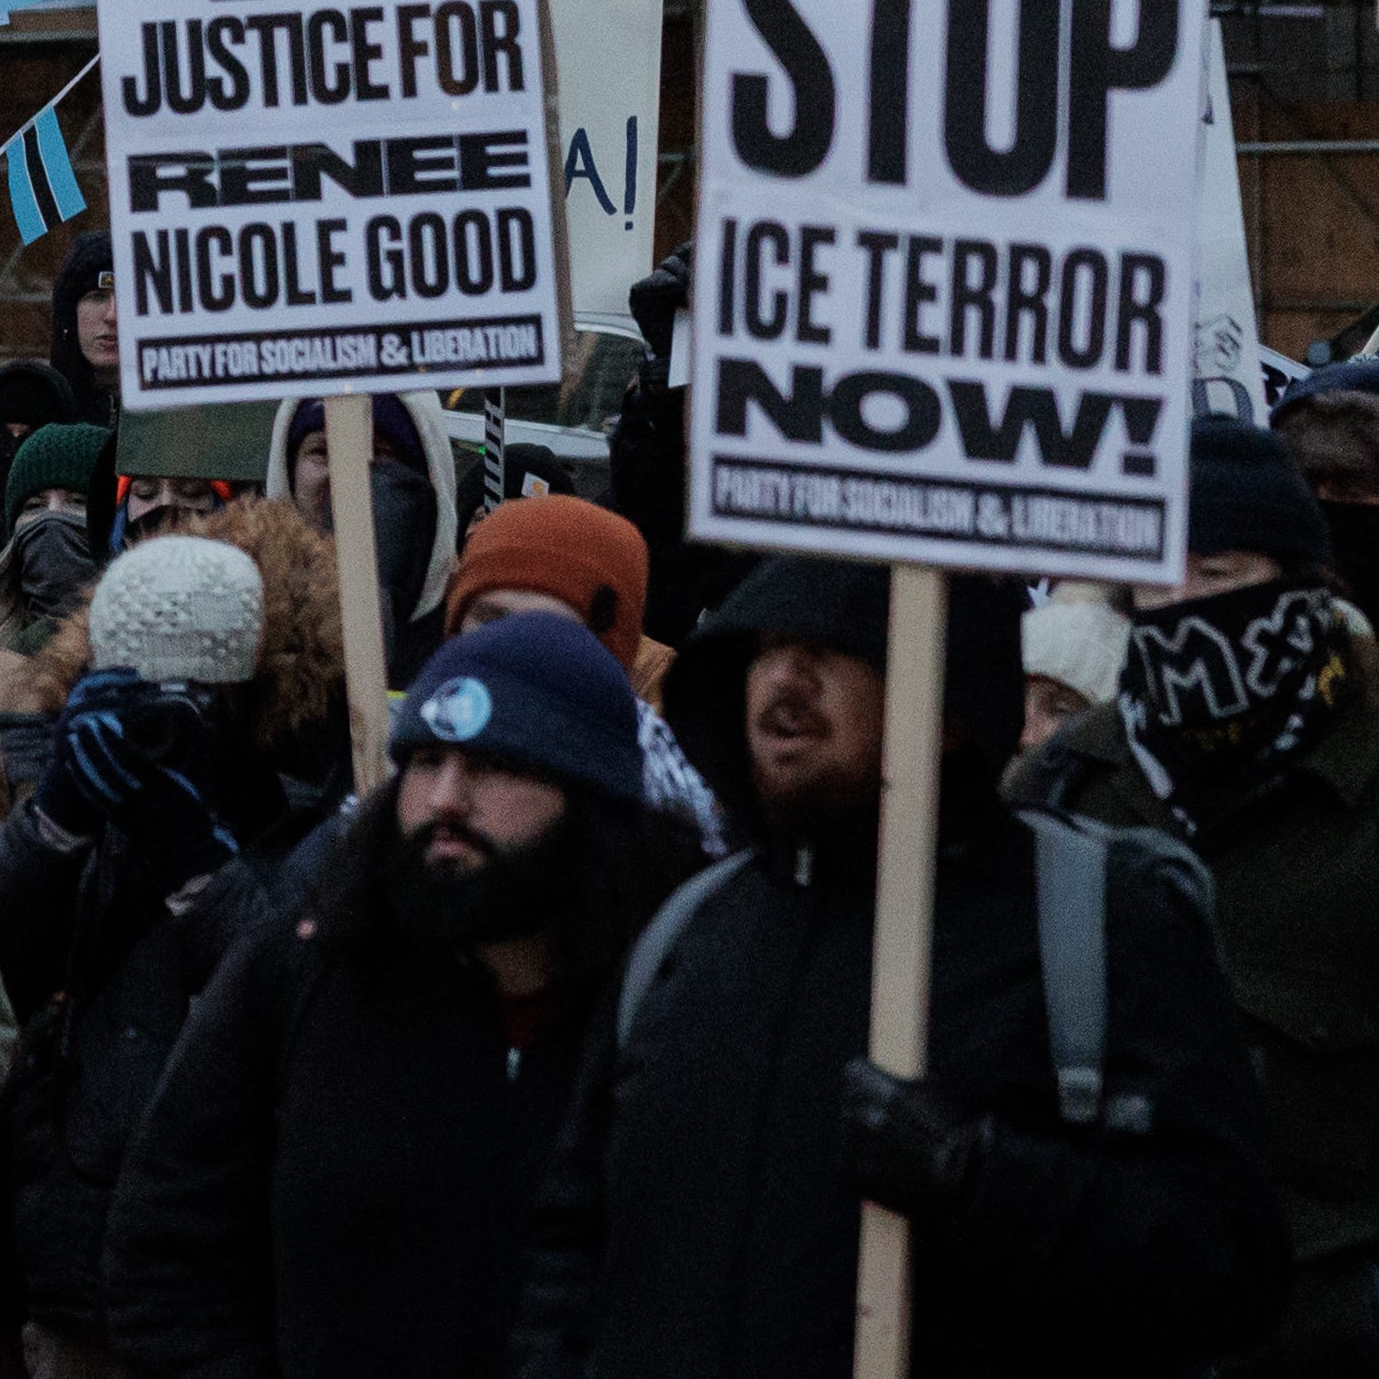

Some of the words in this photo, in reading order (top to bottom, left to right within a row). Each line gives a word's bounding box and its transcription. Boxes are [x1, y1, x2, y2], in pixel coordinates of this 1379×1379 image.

[121, 6, 389, 119] JUSTICE
[127, 129, 533, 214] RENEE
[131, 217, 353, 316] NICOLE
[365, 206, 537, 302] GOOD
[717, 218, 834, 346] ICE
[858, 229, 1167, 376] TERROR
[143, 343, 215, 382] PARTY
[215, 341, 259, 377] FOR
[261, 333, 378, 375] SOCIALISM
[380, 333, 410, 363] &
[411, 324, 538, 364] LIBERATION
[715, 355, 1165, 478] NOW!
